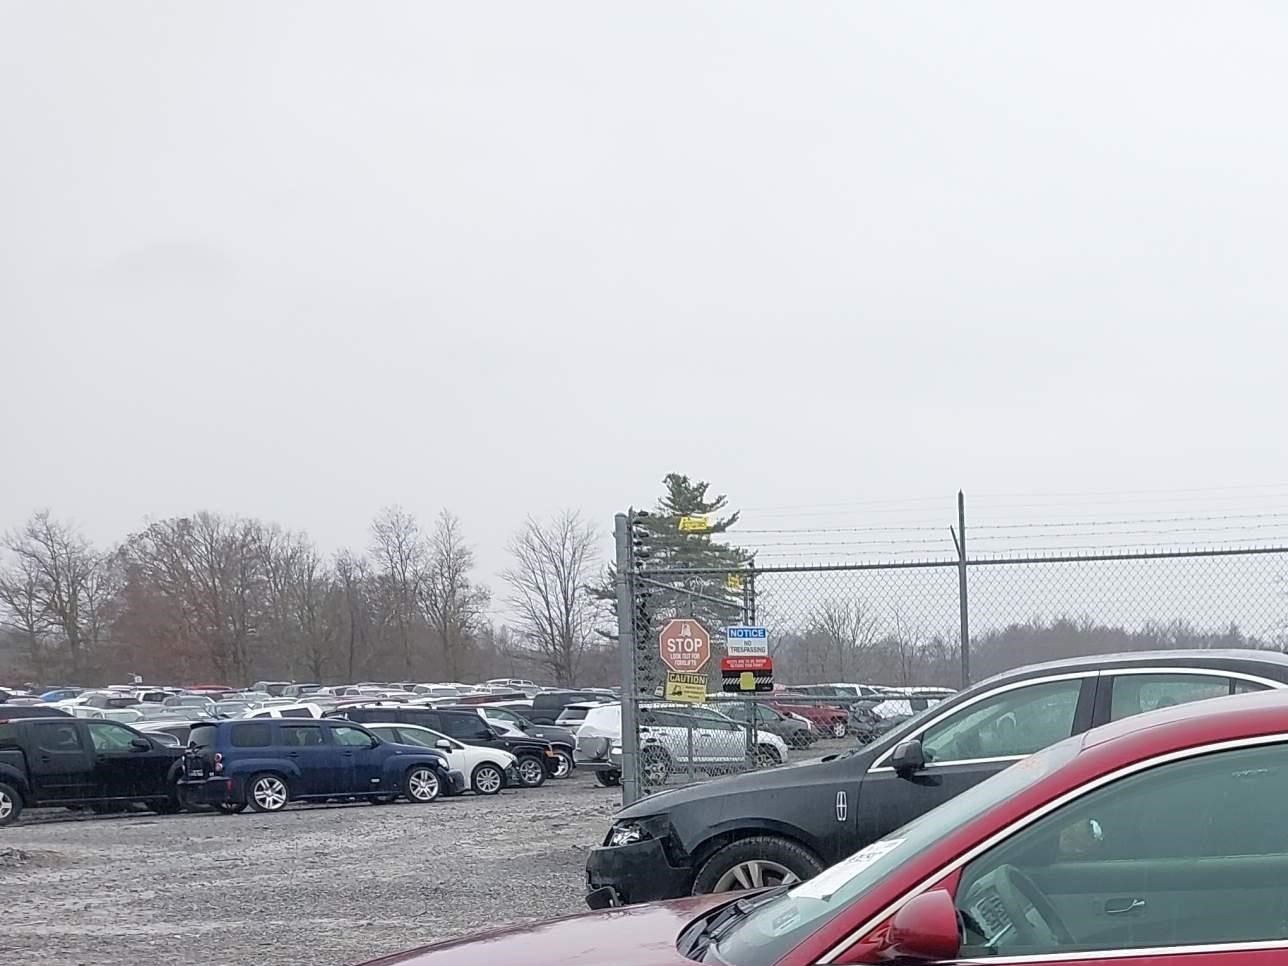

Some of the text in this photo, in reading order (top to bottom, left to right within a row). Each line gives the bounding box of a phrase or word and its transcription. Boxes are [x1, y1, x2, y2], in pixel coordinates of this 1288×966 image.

[730, 629, 765, 637] NOTICE
[667, 638, 703, 653] STOP
[669, 674, 705, 685] CAUTION
